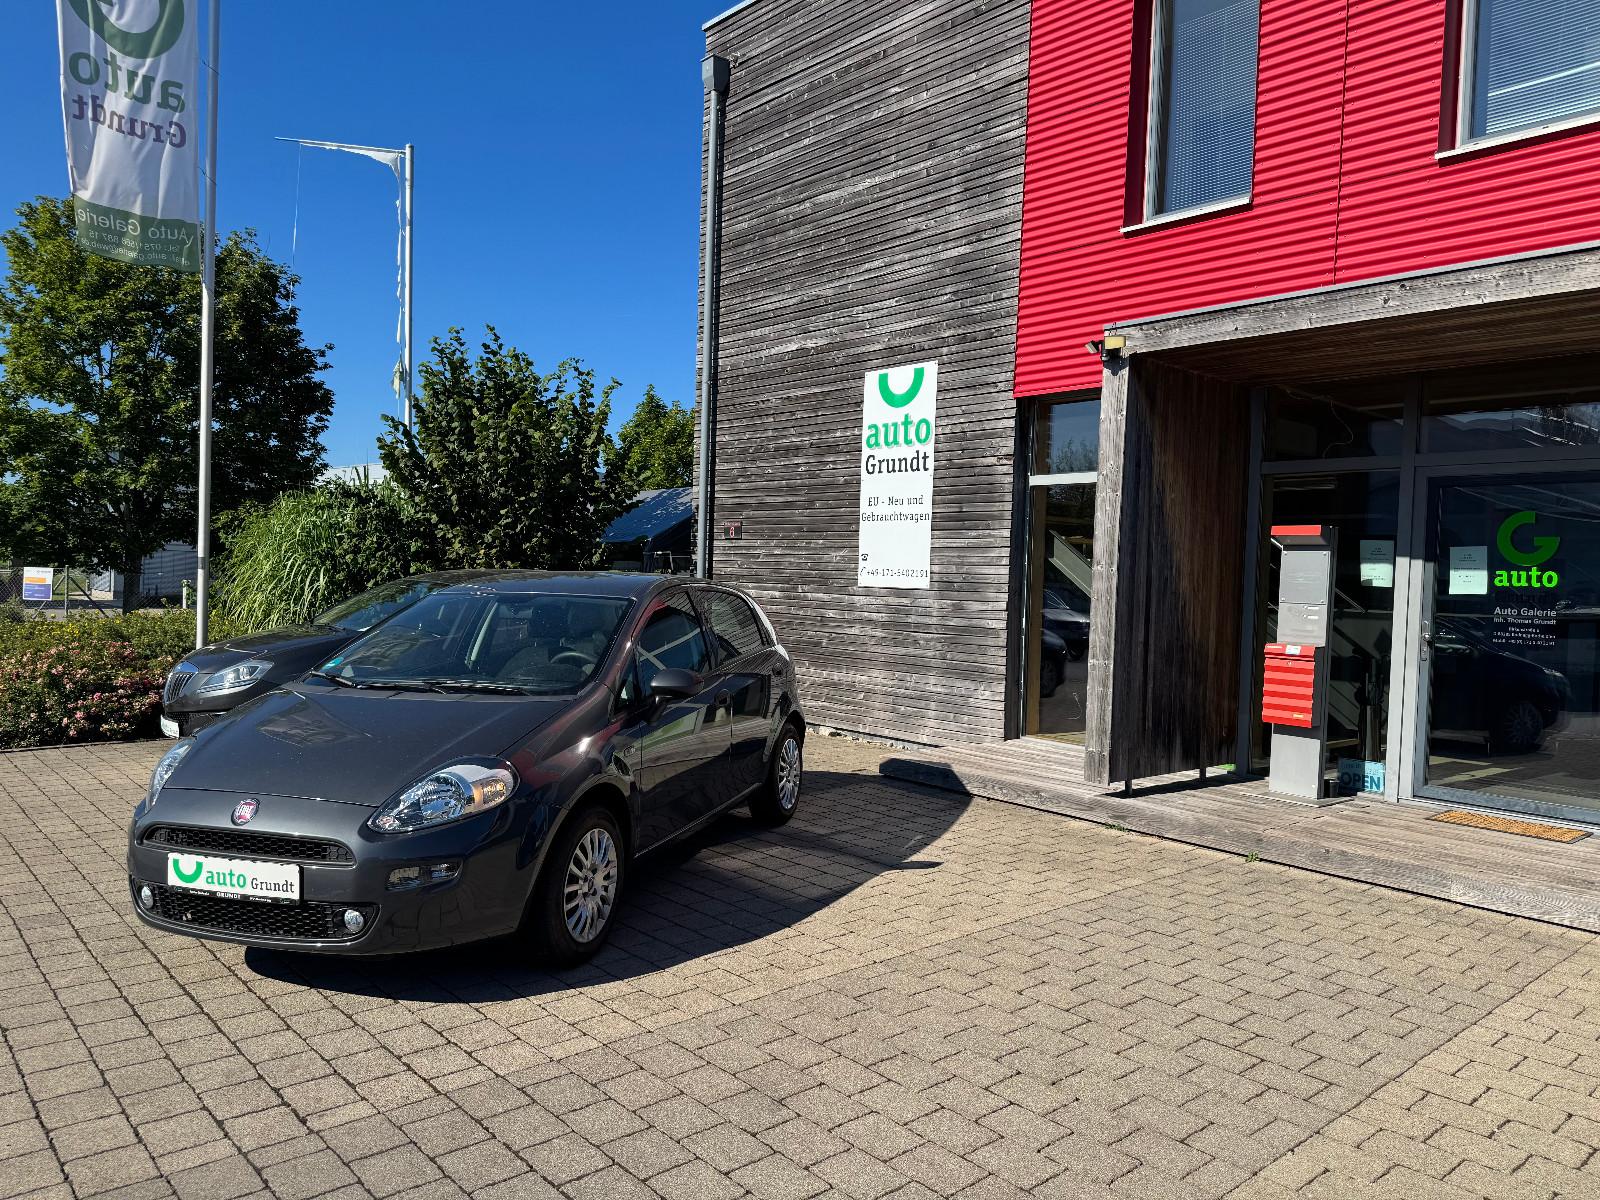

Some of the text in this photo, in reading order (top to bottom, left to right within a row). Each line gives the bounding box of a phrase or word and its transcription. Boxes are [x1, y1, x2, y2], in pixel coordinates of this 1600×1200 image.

[865, 413, 932, 449] auto
[865, 449, 930, 475] Grundt
[868, 496, 879, 506] EU
[888, 496, 904, 506] Neu
[907, 494, 924, 505] und
[861, 511, 930, 523] Gebrauchtwagen
[1493, 566, 1559, 588] auto
[1493, 606, 1557, 617] Auto Galerie
[1341, 771, 1381, 790] OPEN
[205, 868, 295, 893] auto Grundt
